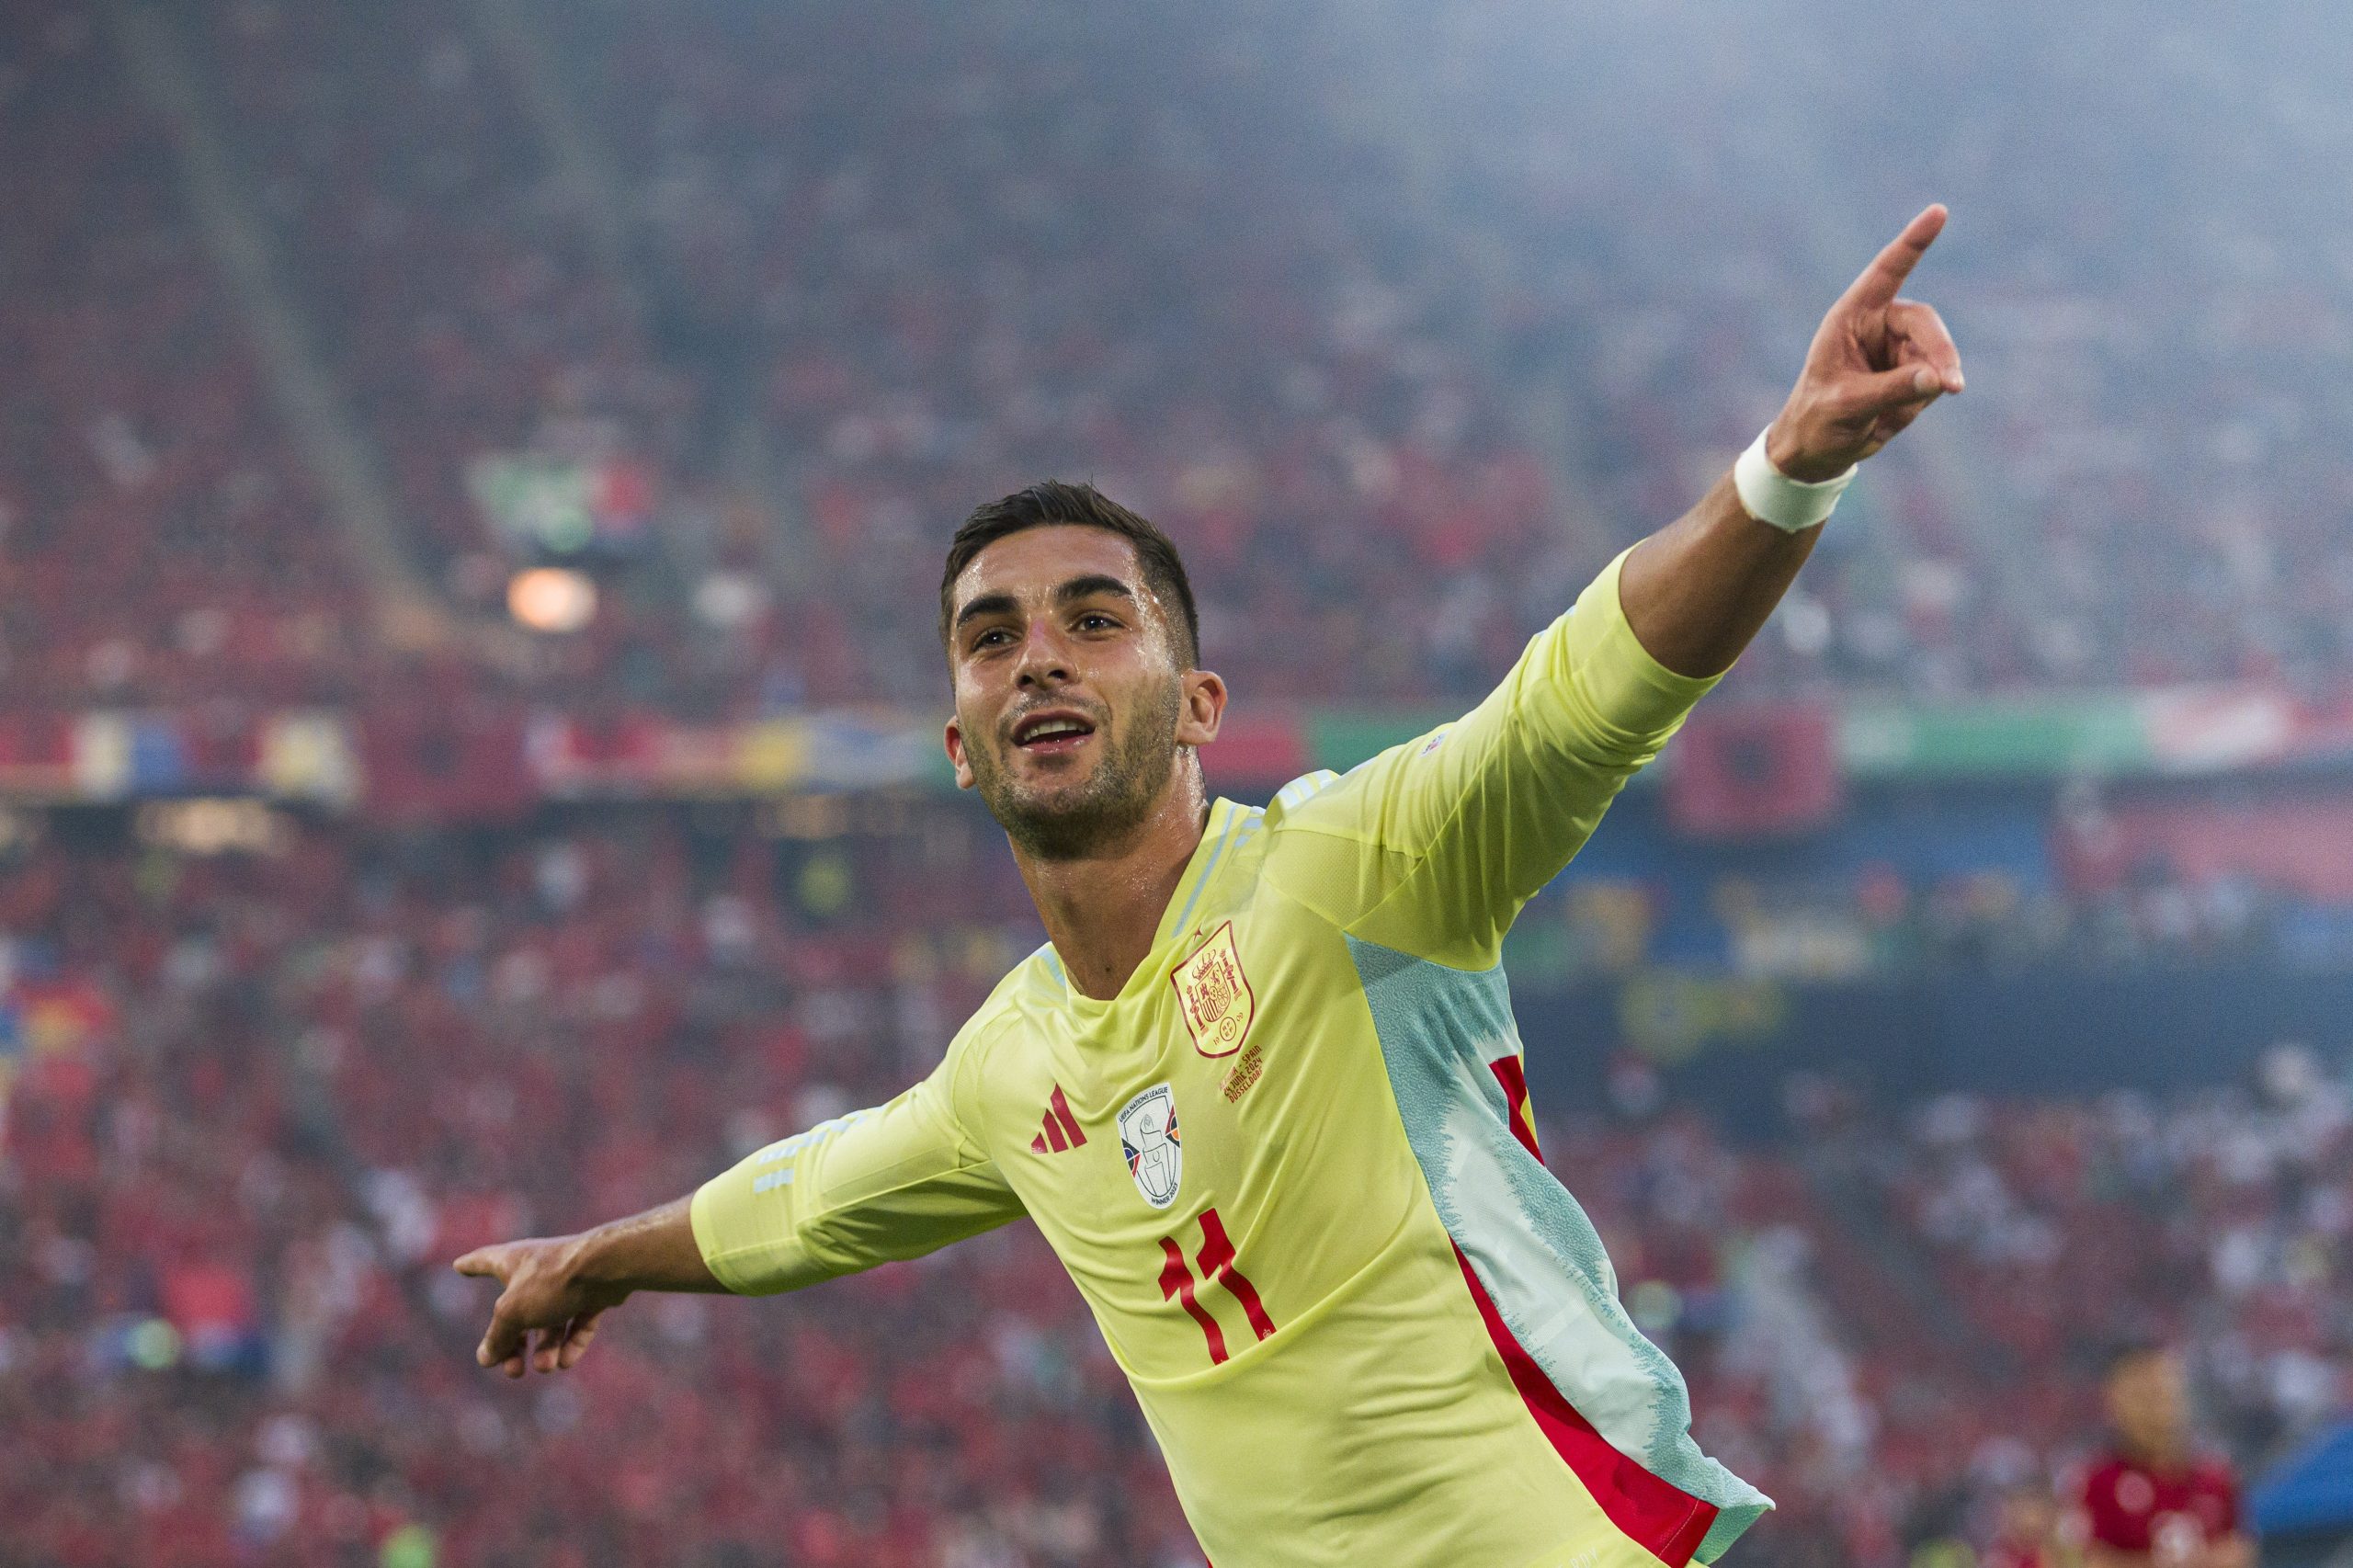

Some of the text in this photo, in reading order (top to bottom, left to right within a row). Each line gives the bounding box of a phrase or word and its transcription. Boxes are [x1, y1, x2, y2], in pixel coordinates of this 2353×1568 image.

[1242, 1045, 1262, 1064] SPAIN
[1230, 1072, 1246, 1088] JUNE
[1245, 1057, 1262, 1074] 2024
[1119, 1086, 1168, 1122] UEFA NATIONS LEAGUE
[1151, 1196, 1171, 1205] WINNER
[1158, 1208, 1278, 1367] 11
